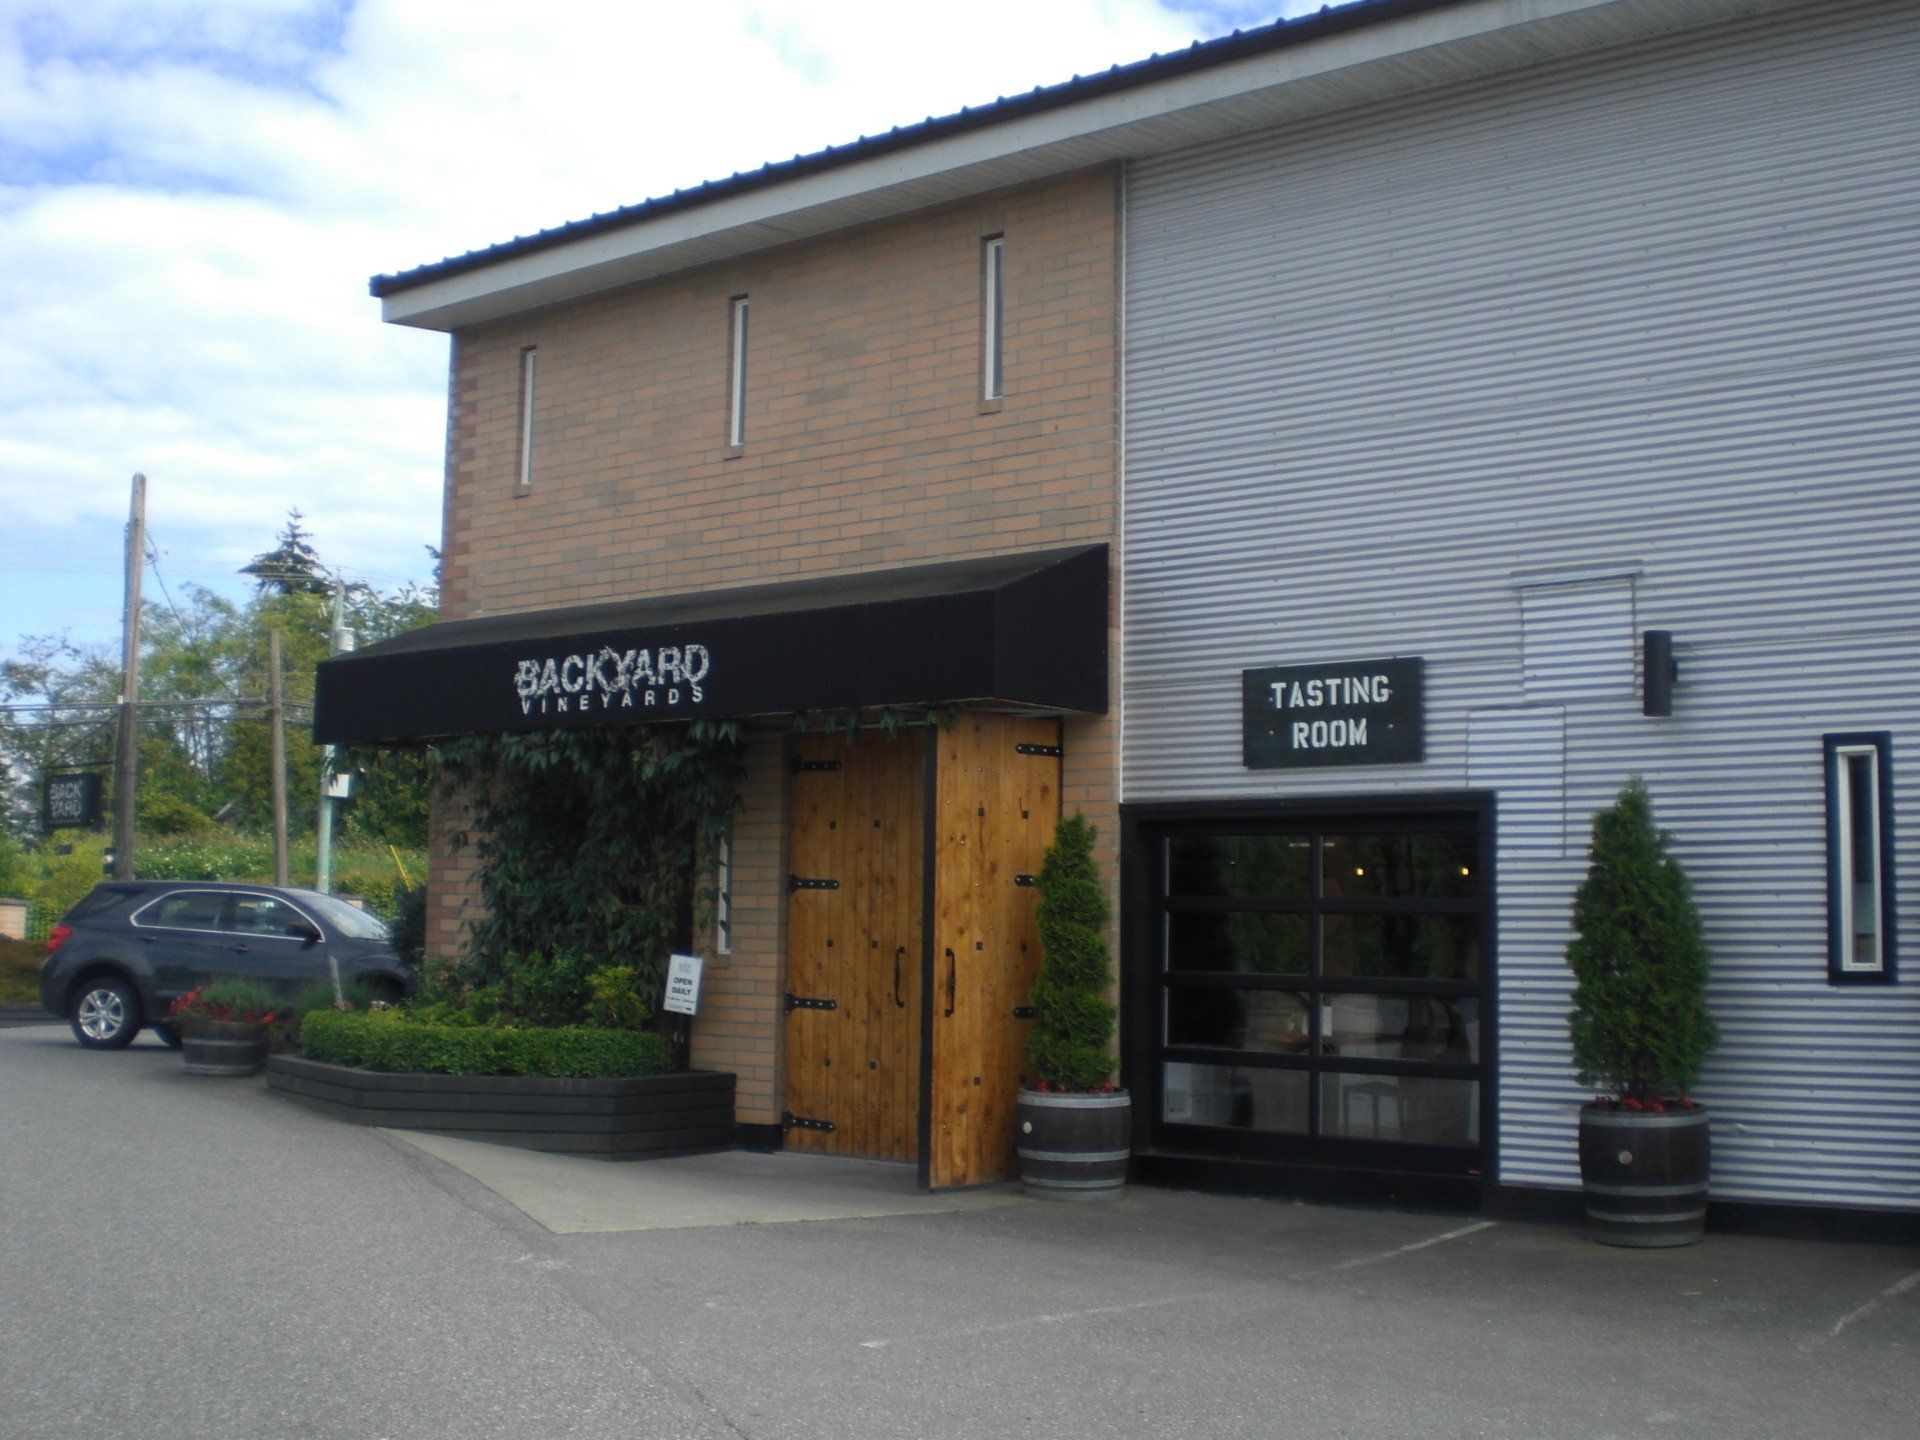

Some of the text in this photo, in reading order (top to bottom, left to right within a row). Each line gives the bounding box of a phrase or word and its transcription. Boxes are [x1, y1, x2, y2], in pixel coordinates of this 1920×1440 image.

[514, 645, 709, 698] BACKYARD
[521, 687, 703, 715] VINEYARDS
[1270, 675, 1390, 709] TASTING
[1293, 718, 1367, 749] ROOM
[672, 987, 691, 995] DAILY
[673, 977, 692, 985] OPEN
